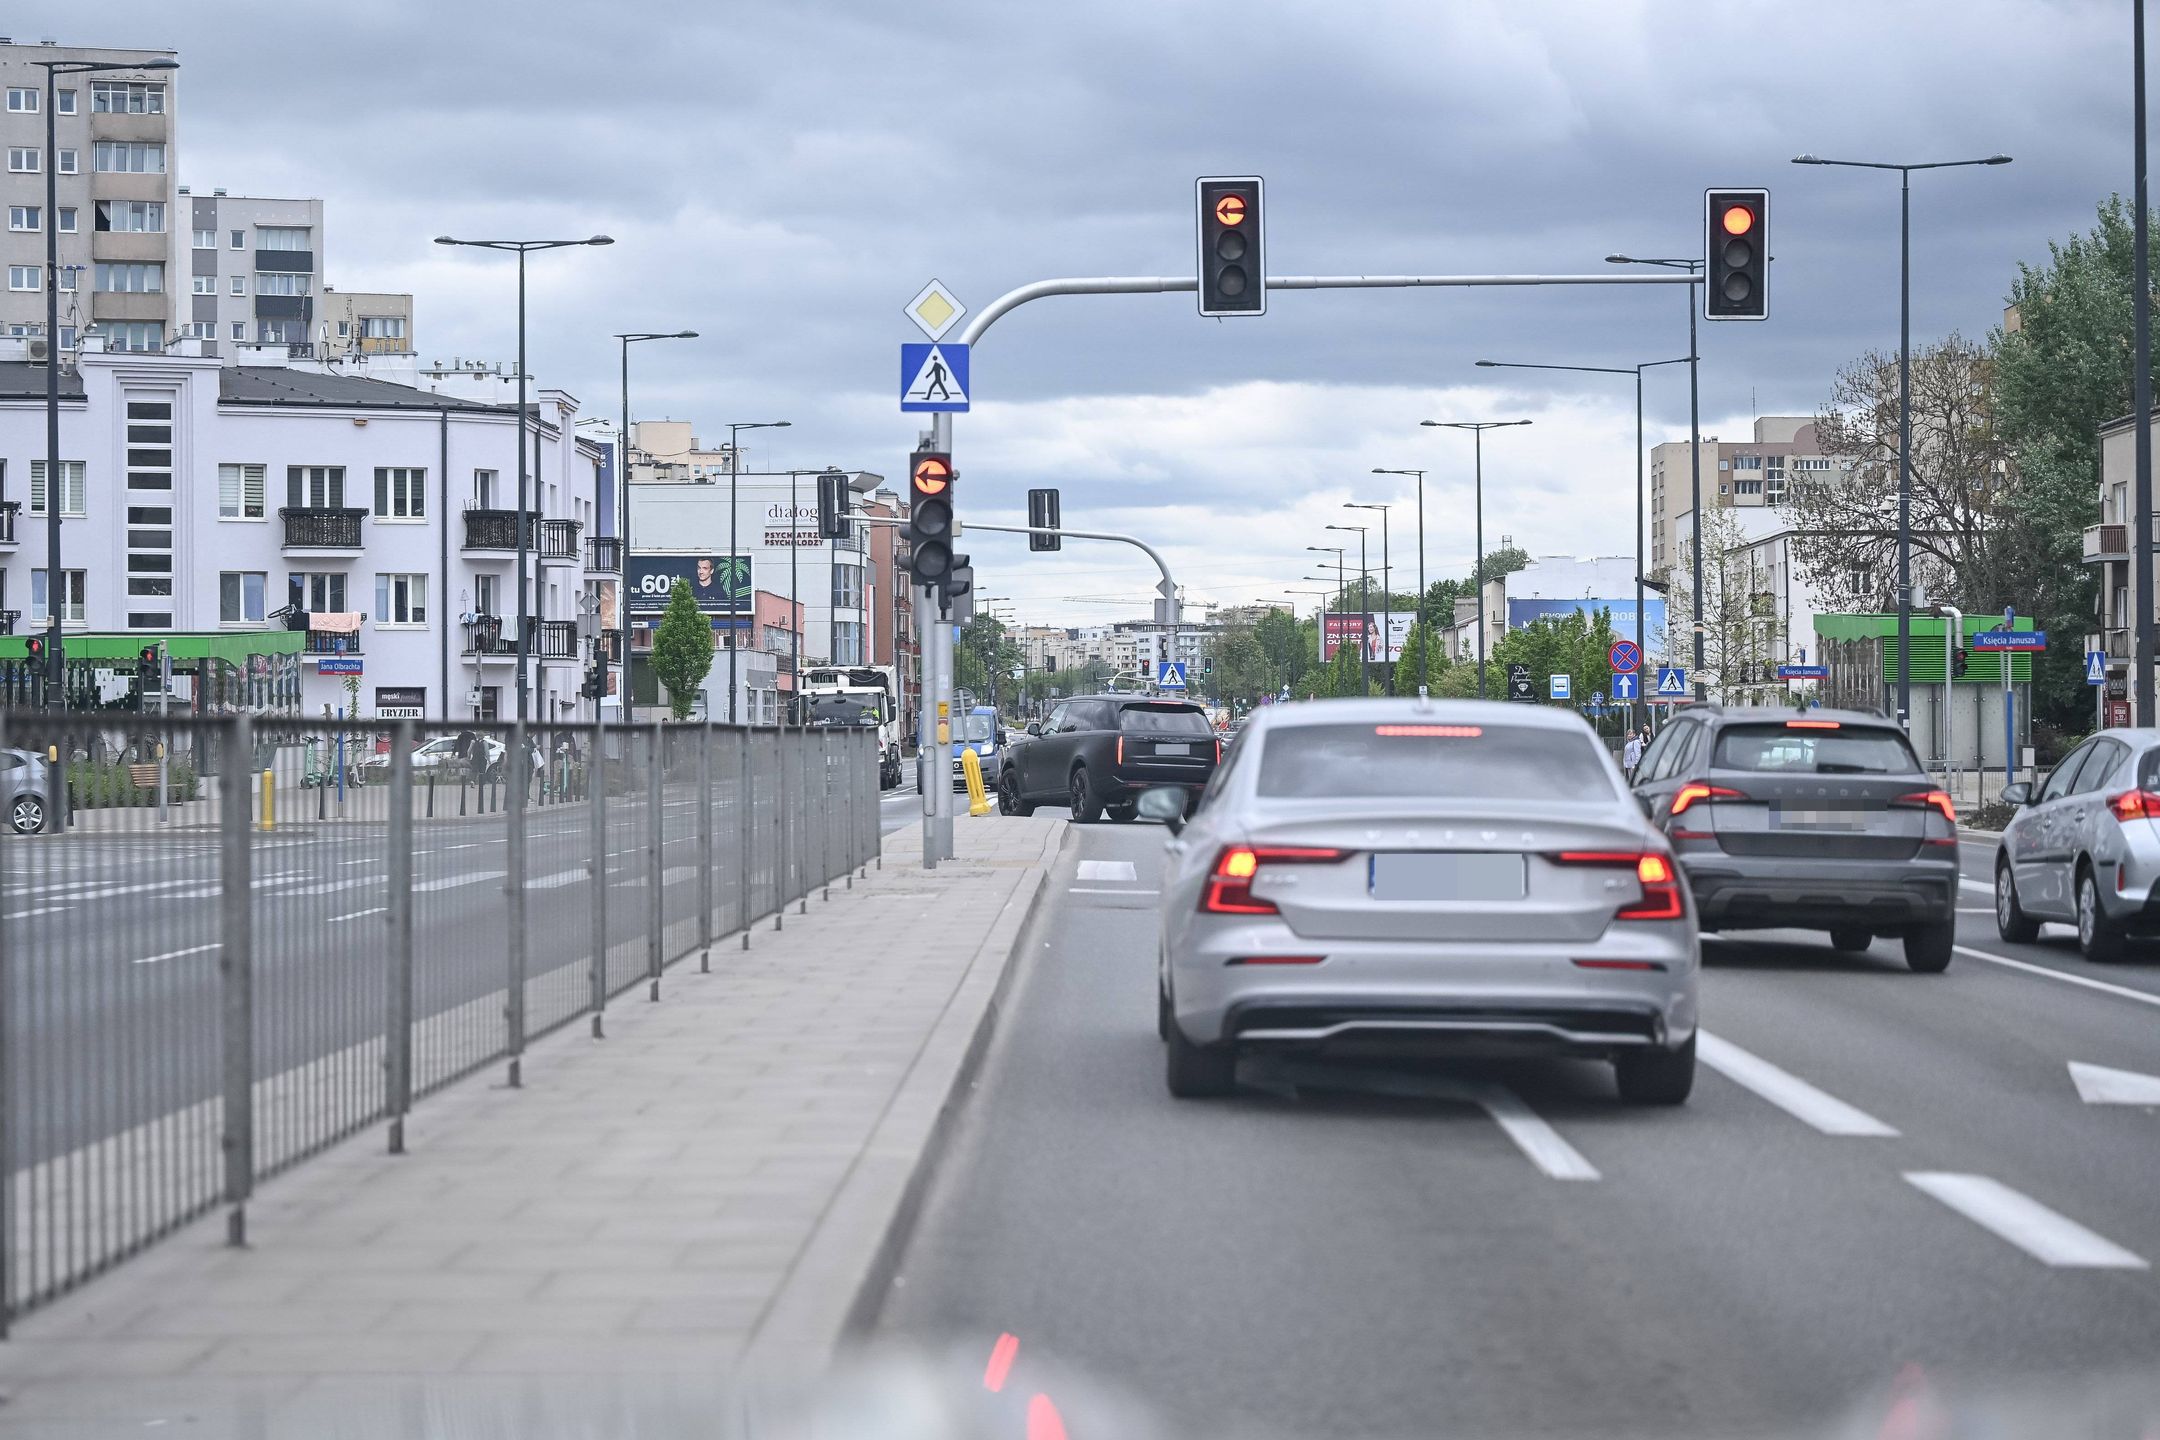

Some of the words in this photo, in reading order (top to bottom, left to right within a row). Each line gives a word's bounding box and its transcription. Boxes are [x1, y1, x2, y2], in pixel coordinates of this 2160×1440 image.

[768, 504, 819, 522] dialog
[630, 586, 640, 594] tu
[641, 574, 670, 594] 60
[1611, 611, 1652, 621] ROBG
[1983, 636, 2007, 646] Księcia
[2008, 636, 2036, 645] Janusza
[334, 662, 361, 670] Olbrachta
